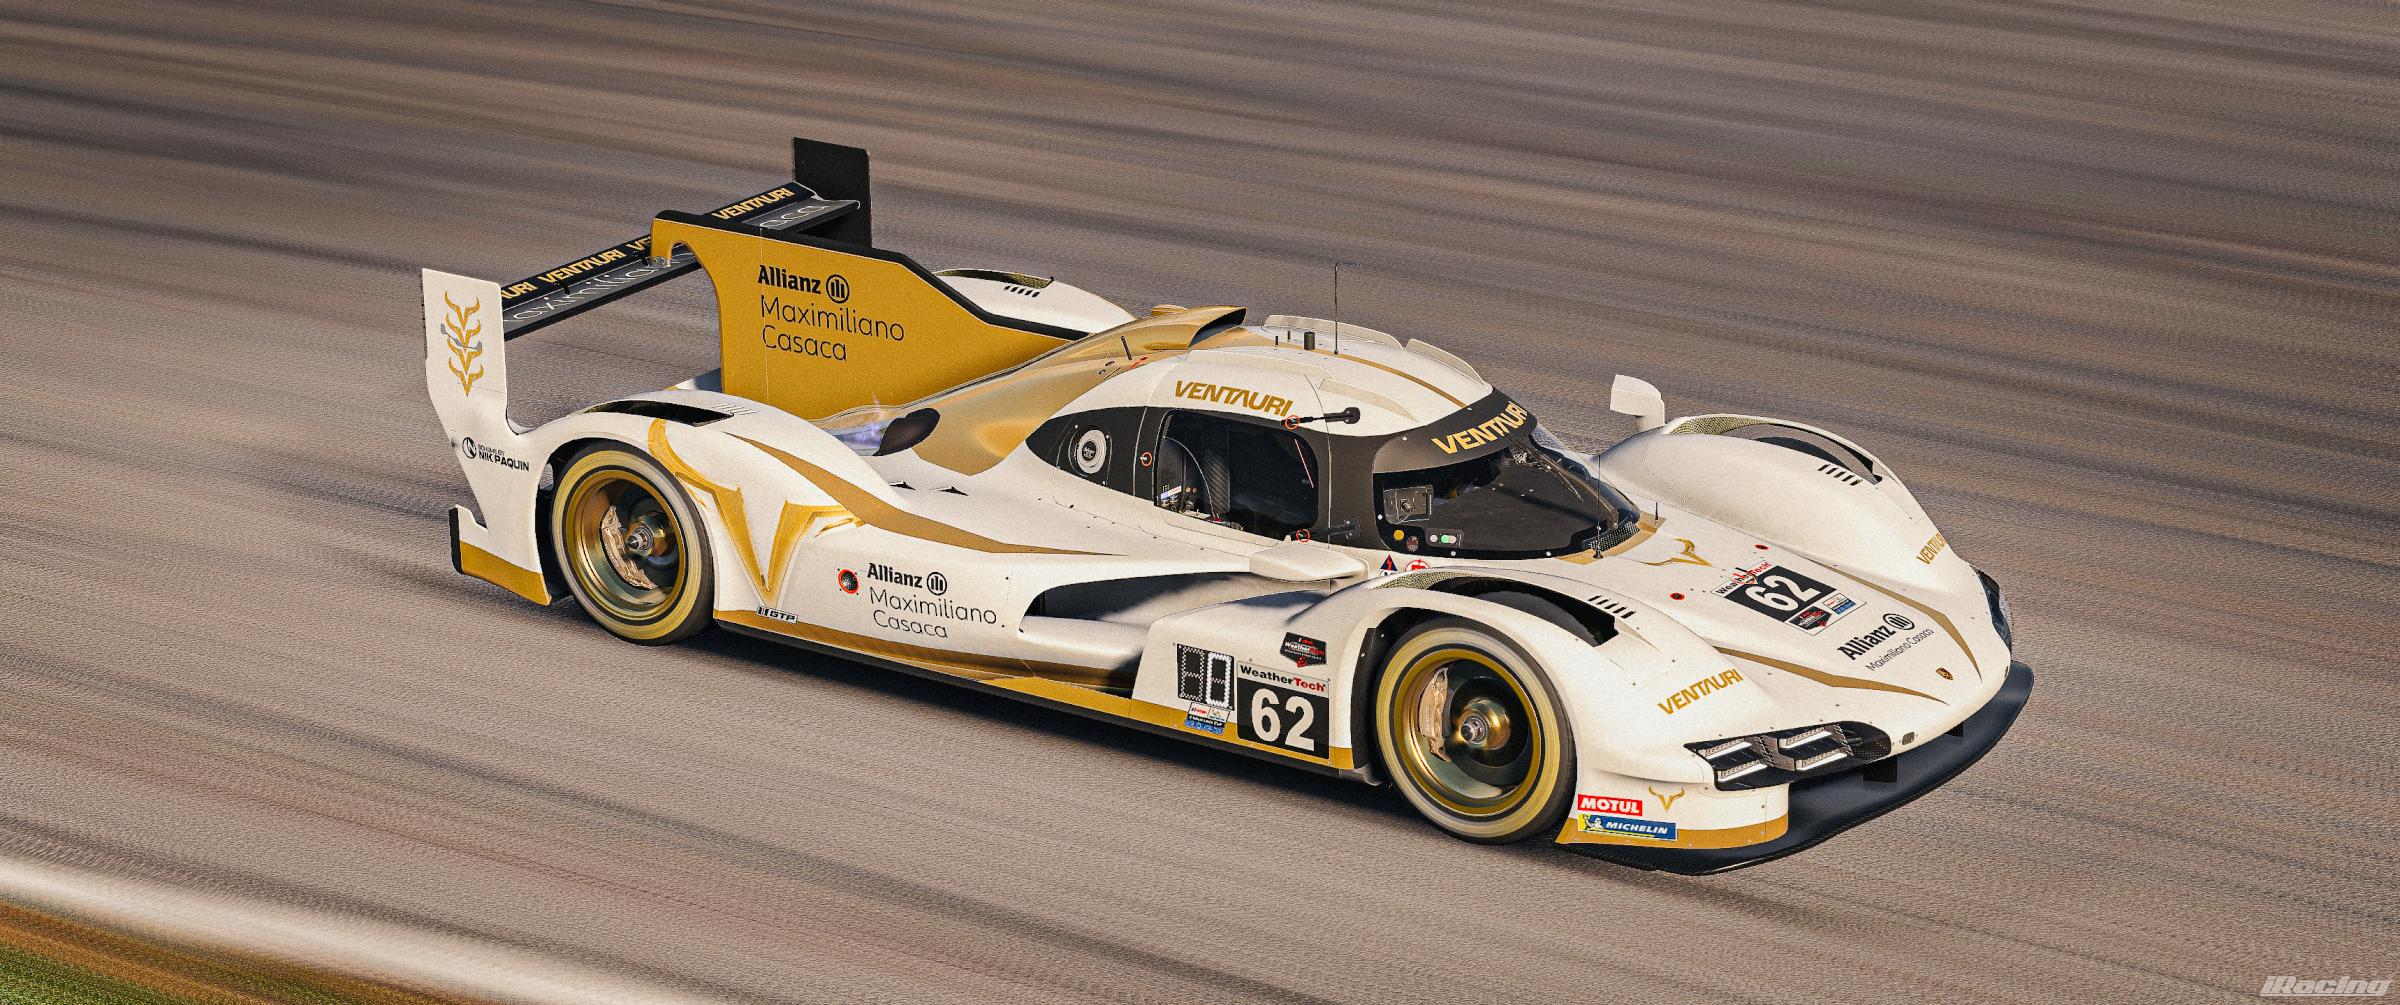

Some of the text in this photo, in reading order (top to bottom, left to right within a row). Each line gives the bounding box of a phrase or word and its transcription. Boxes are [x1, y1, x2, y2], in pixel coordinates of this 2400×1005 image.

[711, 187, 796, 221] VENTAURI
[536, 248, 628, 284] VENTAURI
[757, 264, 822, 294] Allianz
[760, 294, 905, 341] Maximiliano
[762, 324, 847, 362] Casaca
[1173, 379, 1294, 417] VENTAURI
[1431, 400, 1528, 455] VENTAURI
[478, 450, 530, 472] NIK PAQUIN
[867, 562, 923, 589] Allianz
[1745, 575, 1822, 611] 62
[869, 586, 997, 625] Maximiliano
[873, 609, 948, 639] Casaca
[1836, 625, 1897, 660] Allianz
[1865, 628, 1935, 671] Maximiliano Casaca
[1240, 664, 1326, 692] WeatherTech
[1657, 668, 1744, 716] VENTAURI
[1251, 688, 1315, 752] 62
[1579, 797, 1641, 815] MOTUL
[1605, 821, 1669, 835] MICHELIN
